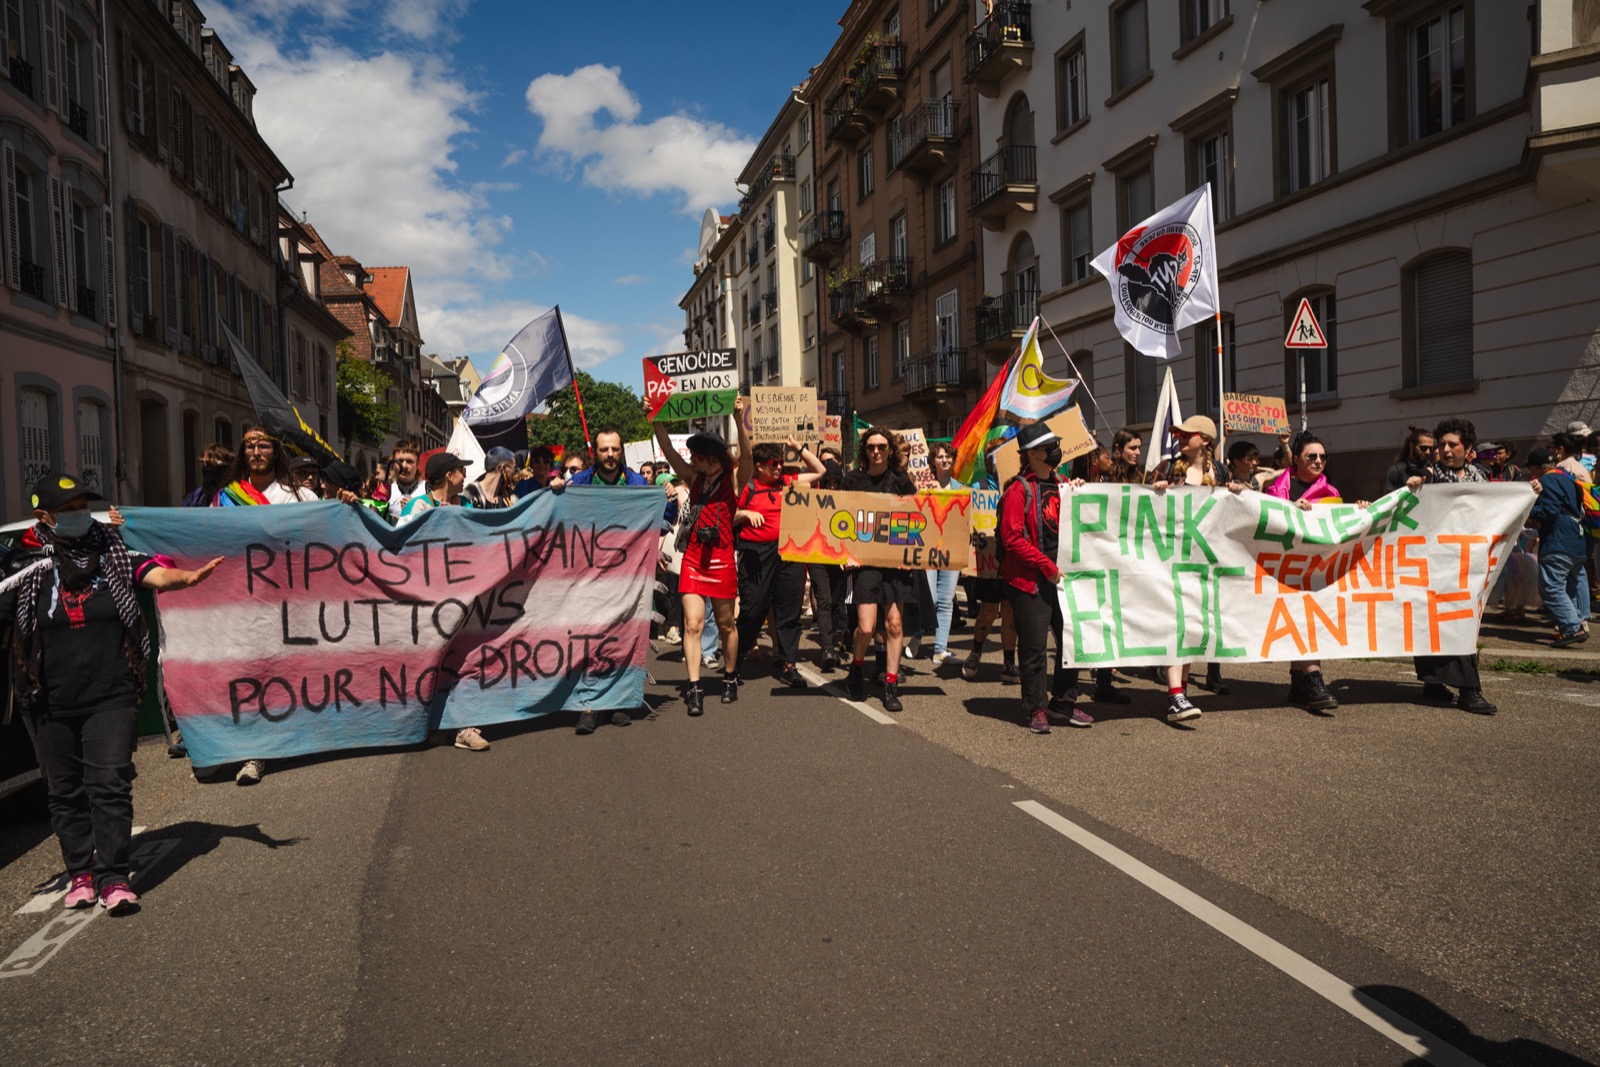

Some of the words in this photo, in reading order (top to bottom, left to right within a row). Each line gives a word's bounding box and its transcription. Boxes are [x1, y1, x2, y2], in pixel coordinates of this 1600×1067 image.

[647, 378, 676, 399] PAS
[681, 379, 697, 392] EN
[702, 375, 731, 389] NOS
[800, 394, 808, 402] DE
[1224, 392, 1261, 404] BARDELLA
[667, 393, 724, 418] NOMS
[1228, 413, 1242, 421] LES
[1243, 415, 1265, 425] QUEER
[1268, 418, 1277, 427] NE
[784, 489, 810, 507] ON
[816, 494, 836, 510] VA
[829, 509, 928, 547] QUEER
[1253, 489, 1420, 551] QUEER
[489, 521, 628, 572] TRANS
[903, 547, 922, 567] LE
[928, 548, 950, 568] RN
[282, 580, 526, 646] LUTTONS
[1063, 562, 1247, 663] BLOC
[229, 668, 362, 725] POUR
[380, 651, 460, 708] NOS
